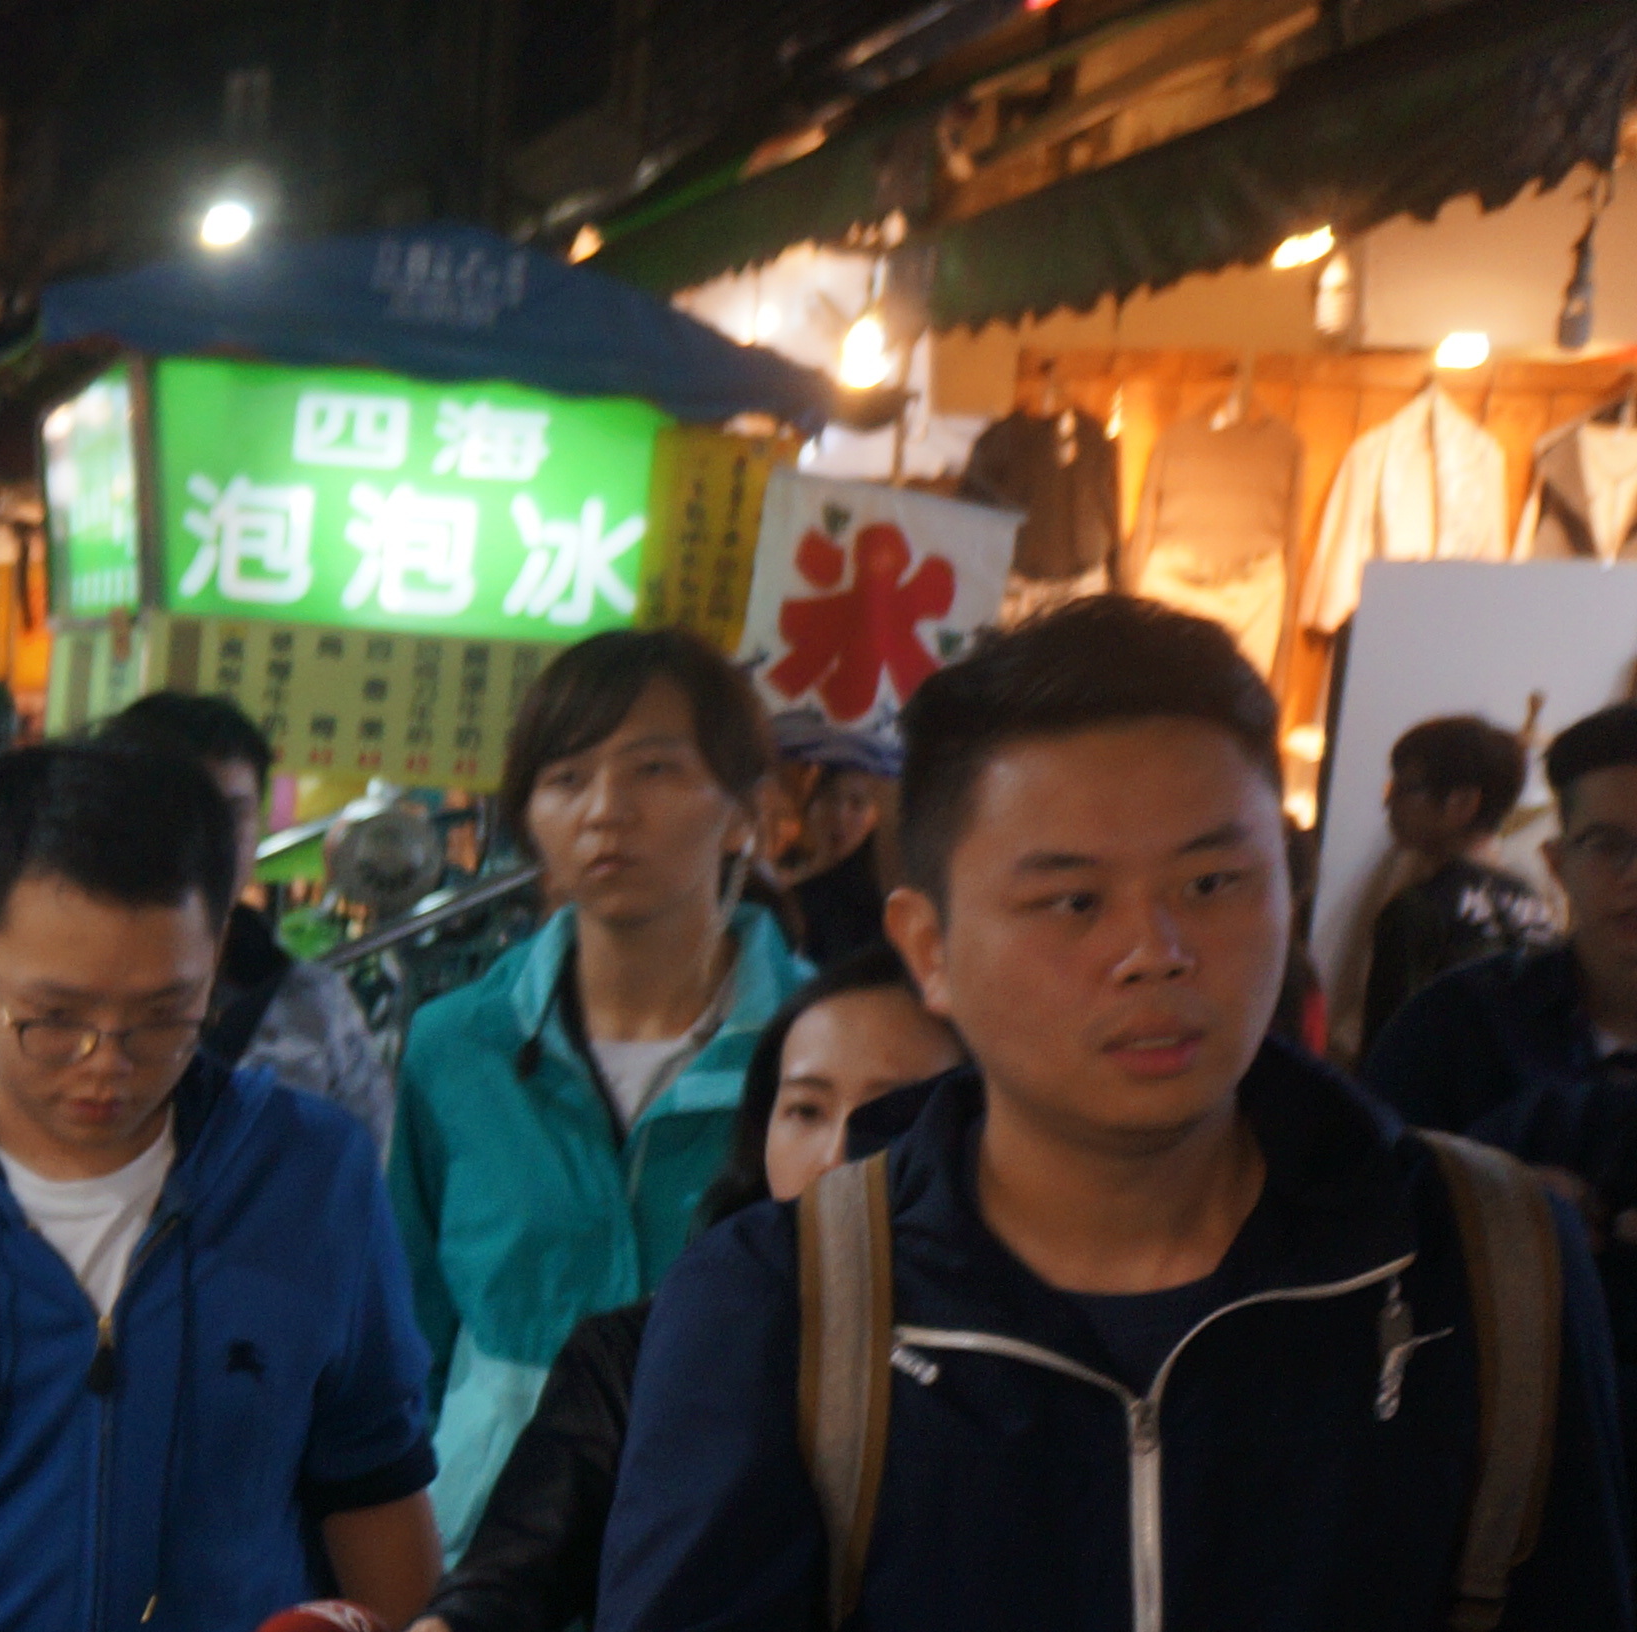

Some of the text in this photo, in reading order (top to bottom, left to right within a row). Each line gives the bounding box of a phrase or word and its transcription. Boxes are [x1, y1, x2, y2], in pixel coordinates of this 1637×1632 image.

[293, 390, 553, 484] 四海
[179, 476, 647, 624] 泡泡冰
